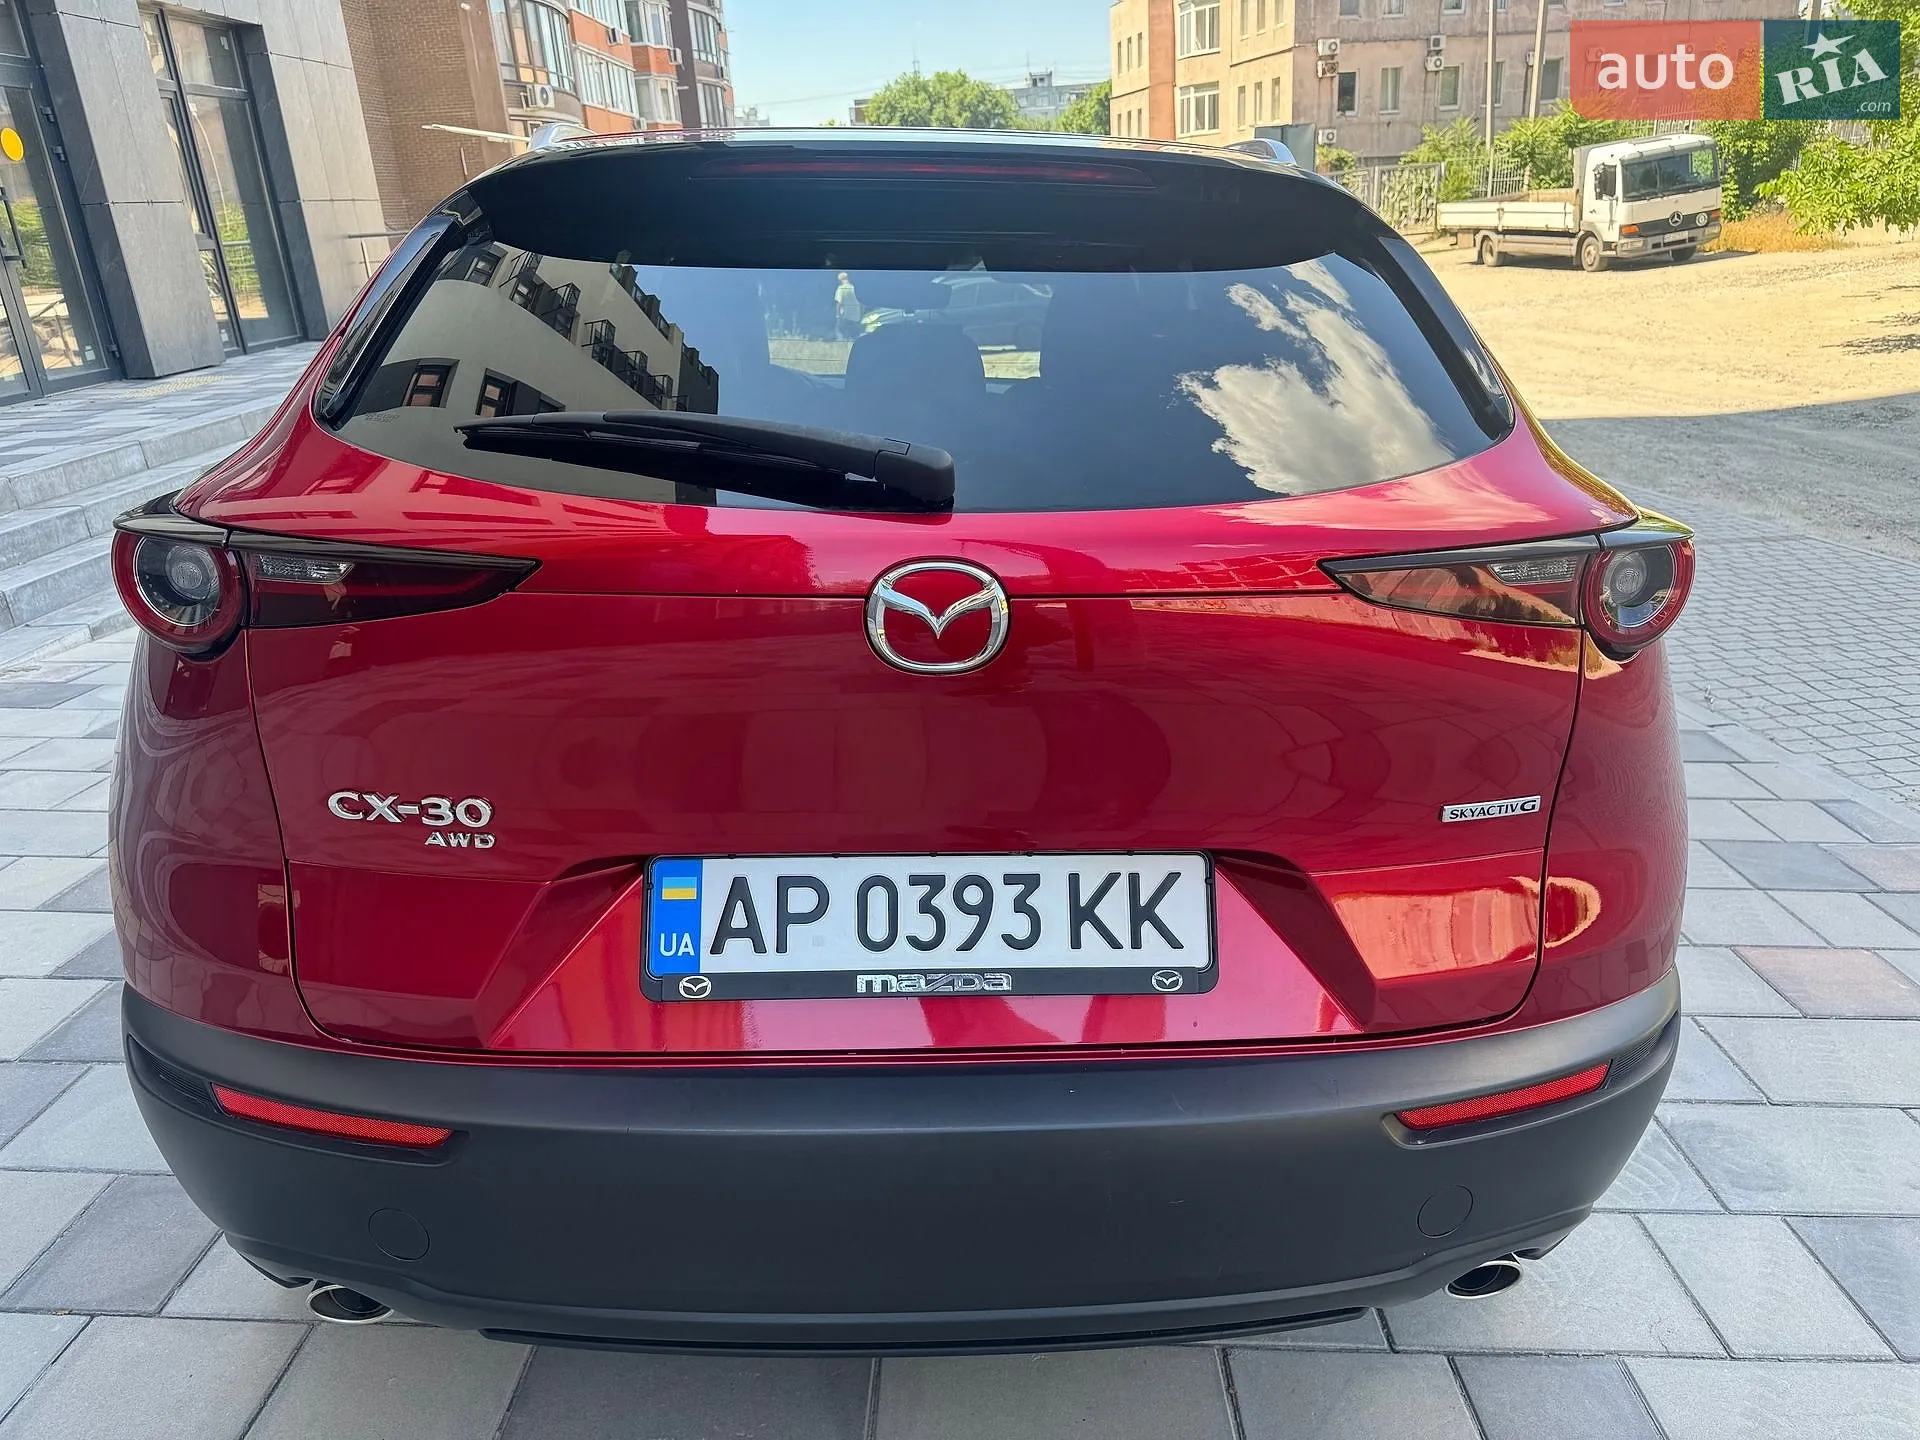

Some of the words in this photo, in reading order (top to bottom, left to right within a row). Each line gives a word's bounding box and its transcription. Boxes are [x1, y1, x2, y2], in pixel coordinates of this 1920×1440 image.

[328, 791, 493, 828] CX-30
[425, 832, 496, 849] AWD
[709, 875, 831, 956] AP
[856, 873, 1042, 952] 0393
[1068, 871, 1185, 950] KK
[659, 932, 696, 957] UA
